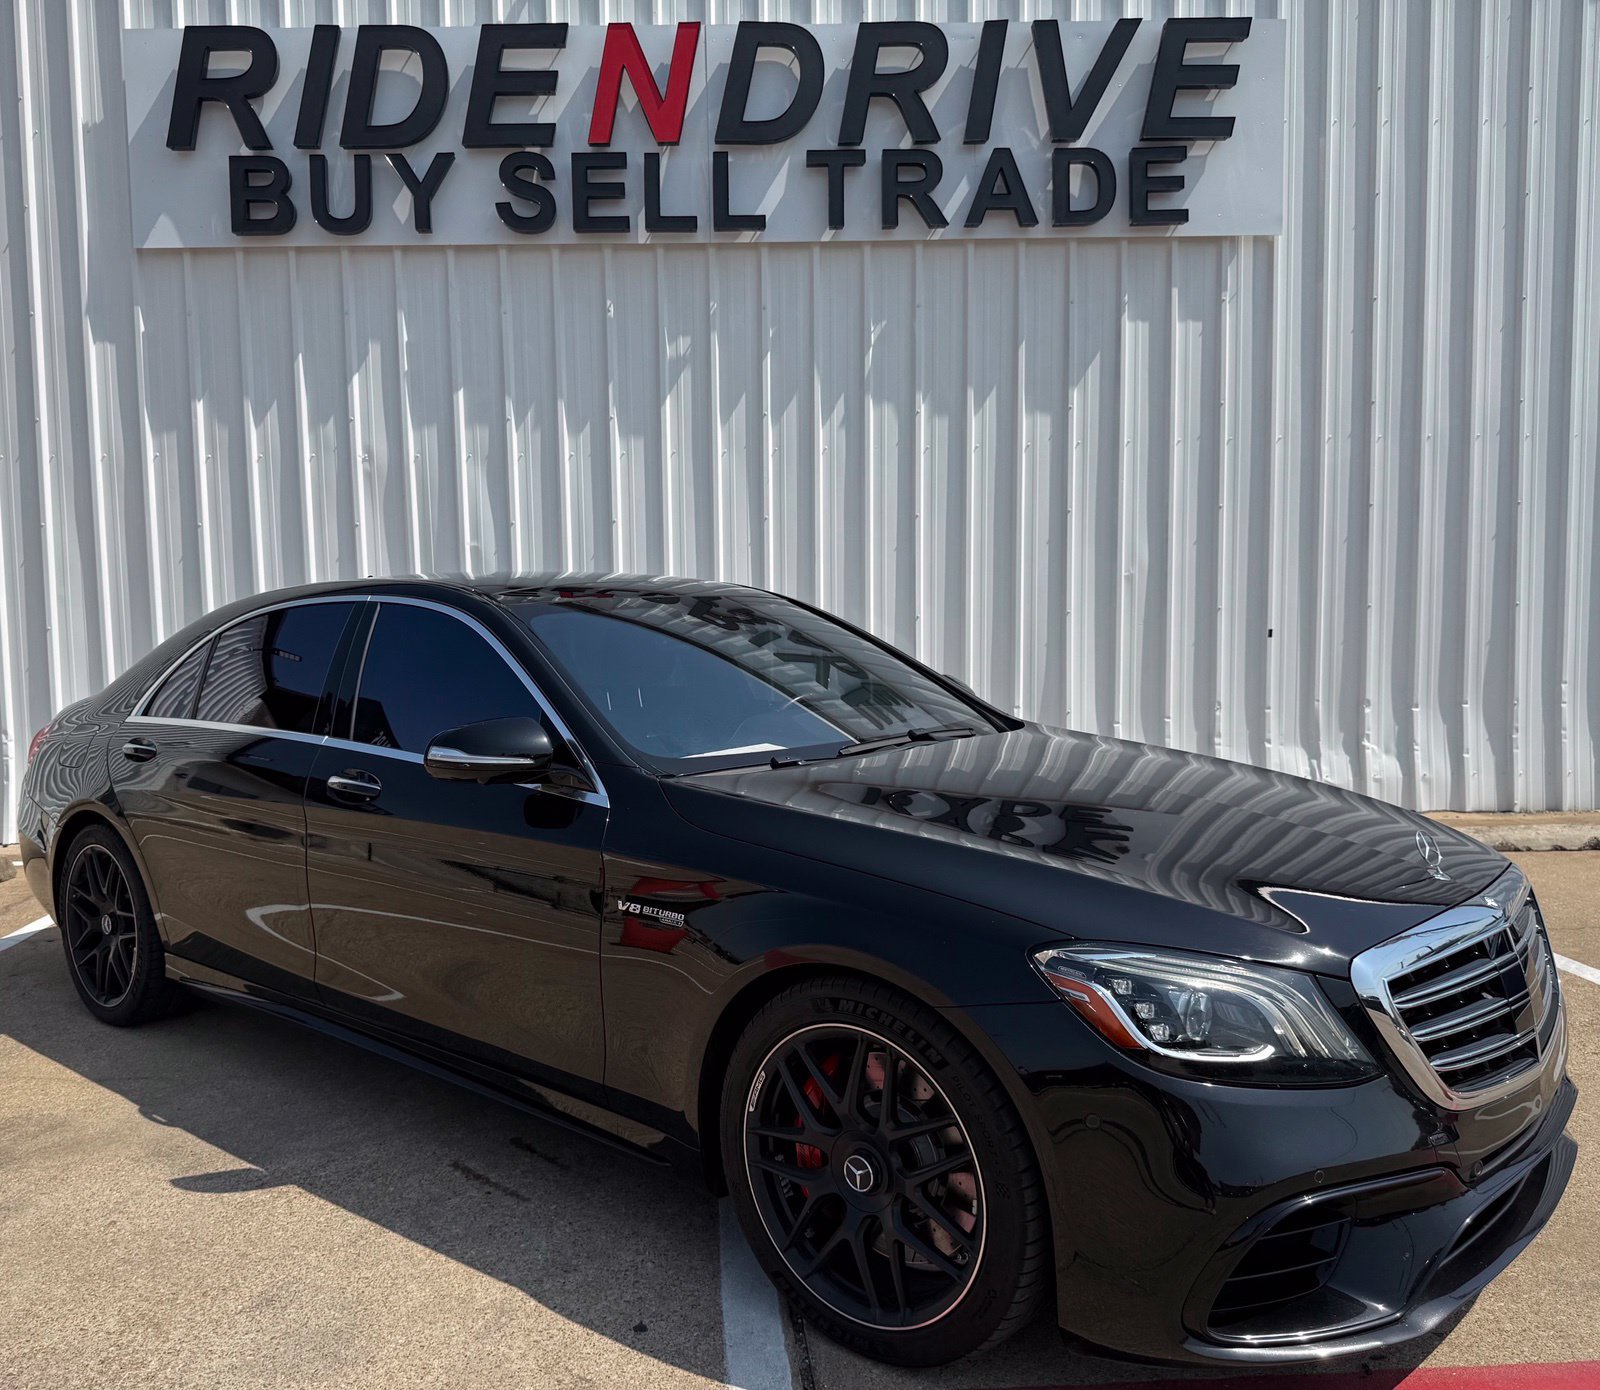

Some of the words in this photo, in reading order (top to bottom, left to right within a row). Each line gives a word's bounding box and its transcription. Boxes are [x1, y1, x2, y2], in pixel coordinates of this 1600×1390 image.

[228, 152, 456, 236] BUY
[495, 151, 766, 234] SELL
[806, 146, 1190, 230] TRADE
[617, 899, 641, 914] V8
[642, 905, 685, 921] BITURBO
[836, 997, 945, 1066] MICHELIN
